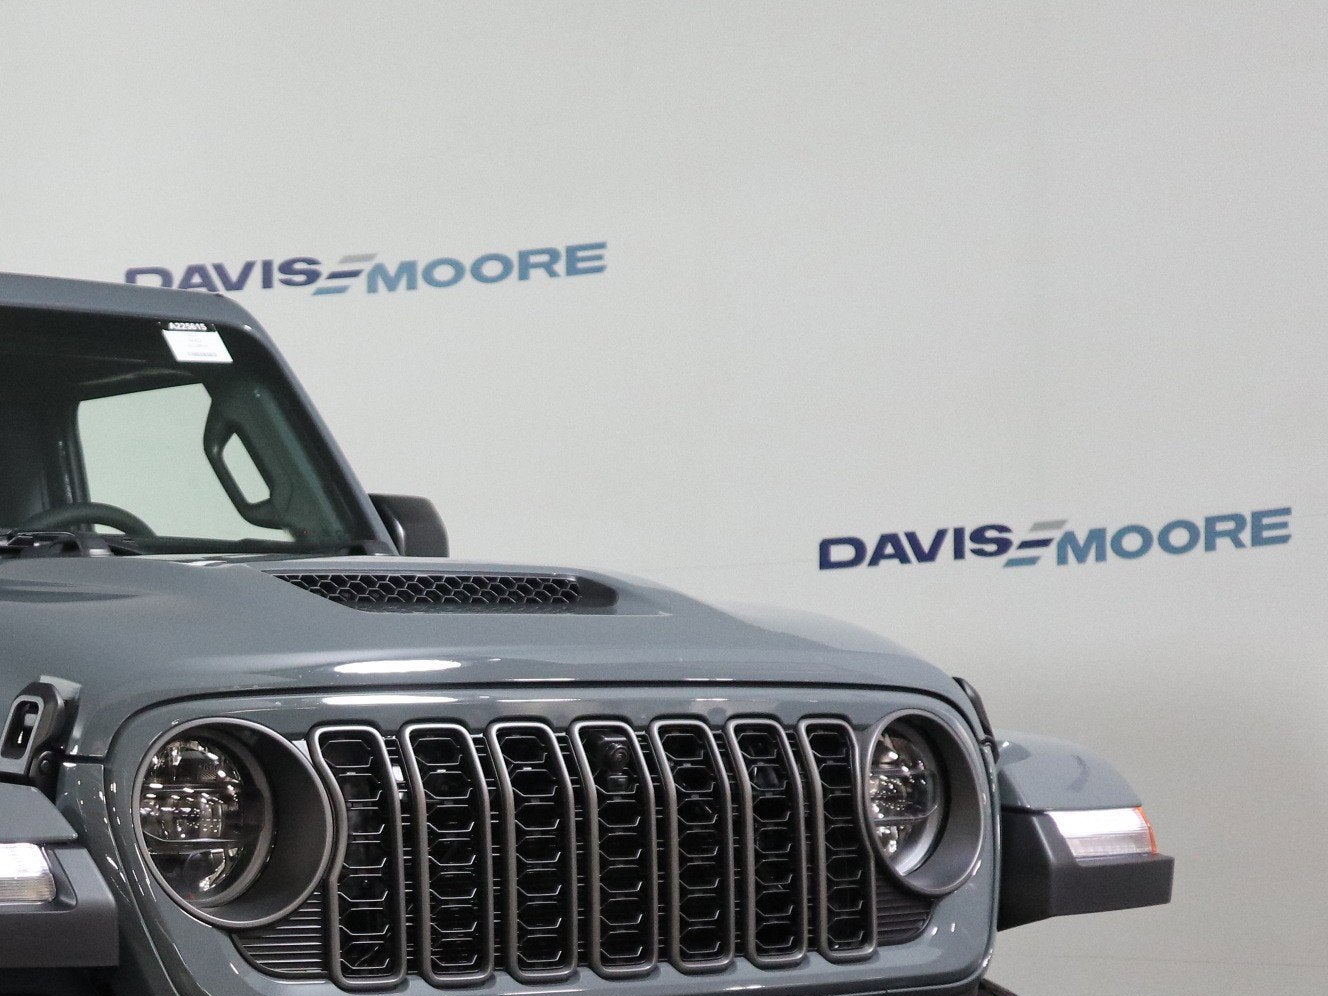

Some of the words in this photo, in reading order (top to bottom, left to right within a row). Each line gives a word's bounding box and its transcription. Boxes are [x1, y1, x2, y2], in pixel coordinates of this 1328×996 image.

[124, 256, 324, 292] DAVIS
[366, 242, 608, 295] MOORE
[819, 523, 1014, 570] DAVIS
[1056, 507, 1292, 567] MOORE
